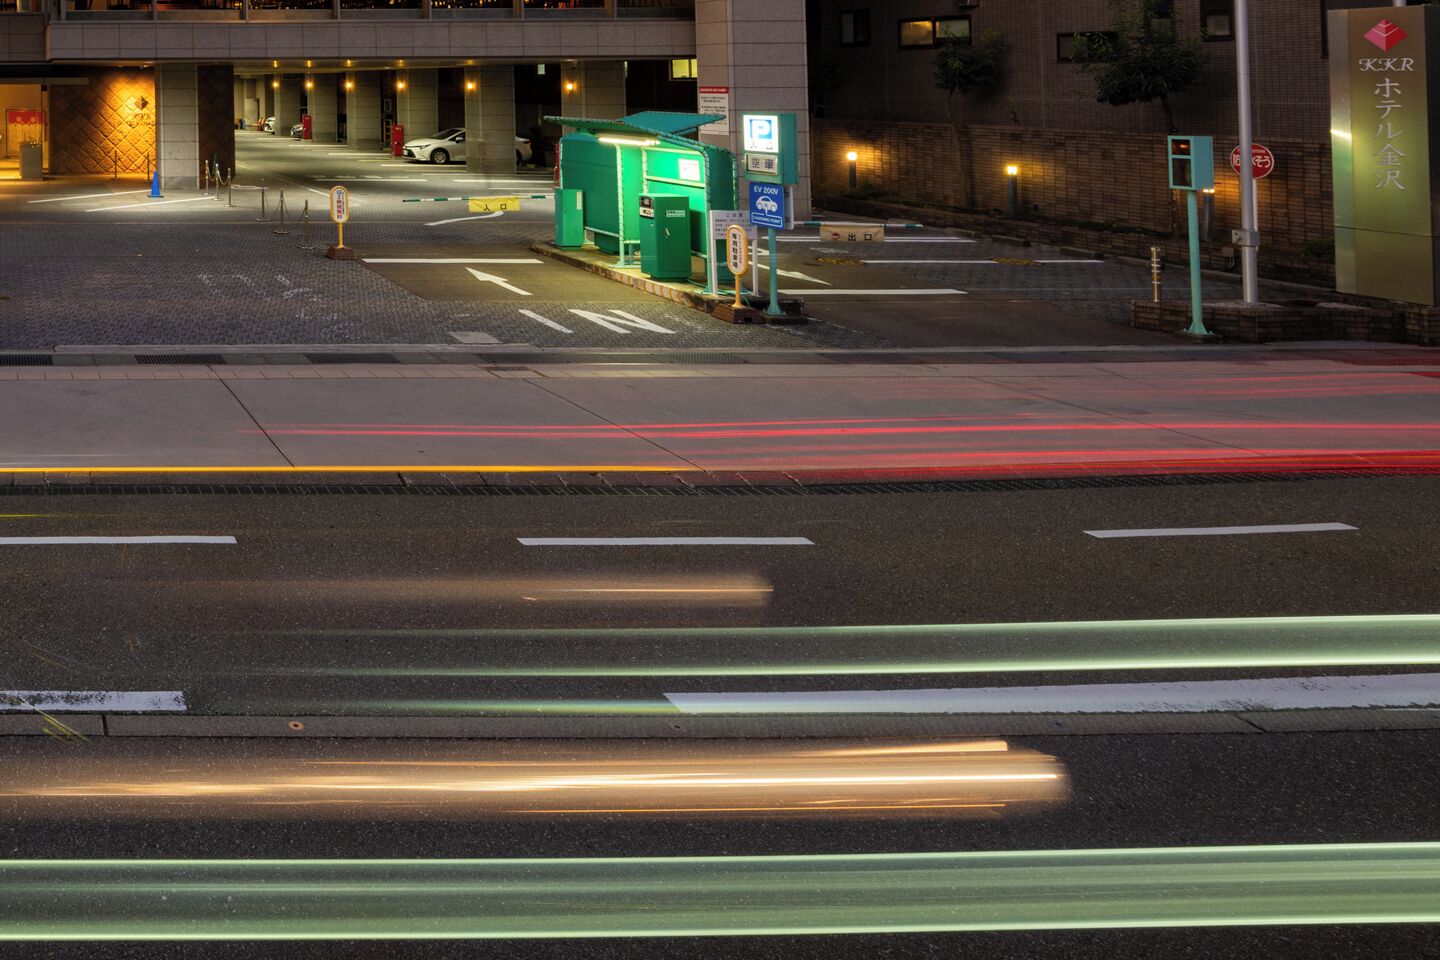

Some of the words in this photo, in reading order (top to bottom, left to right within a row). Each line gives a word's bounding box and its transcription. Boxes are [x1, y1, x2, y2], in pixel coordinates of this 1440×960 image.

[1359, 58, 1414, 71] KKR
[1374, 78, 1408, 190] ホテル金沢
[752, 158, 773, 169] 空車
[754, 185, 762, 193] EV
[763, 186, 779, 195] 200V
[847, 233, 872, 241] 出口
